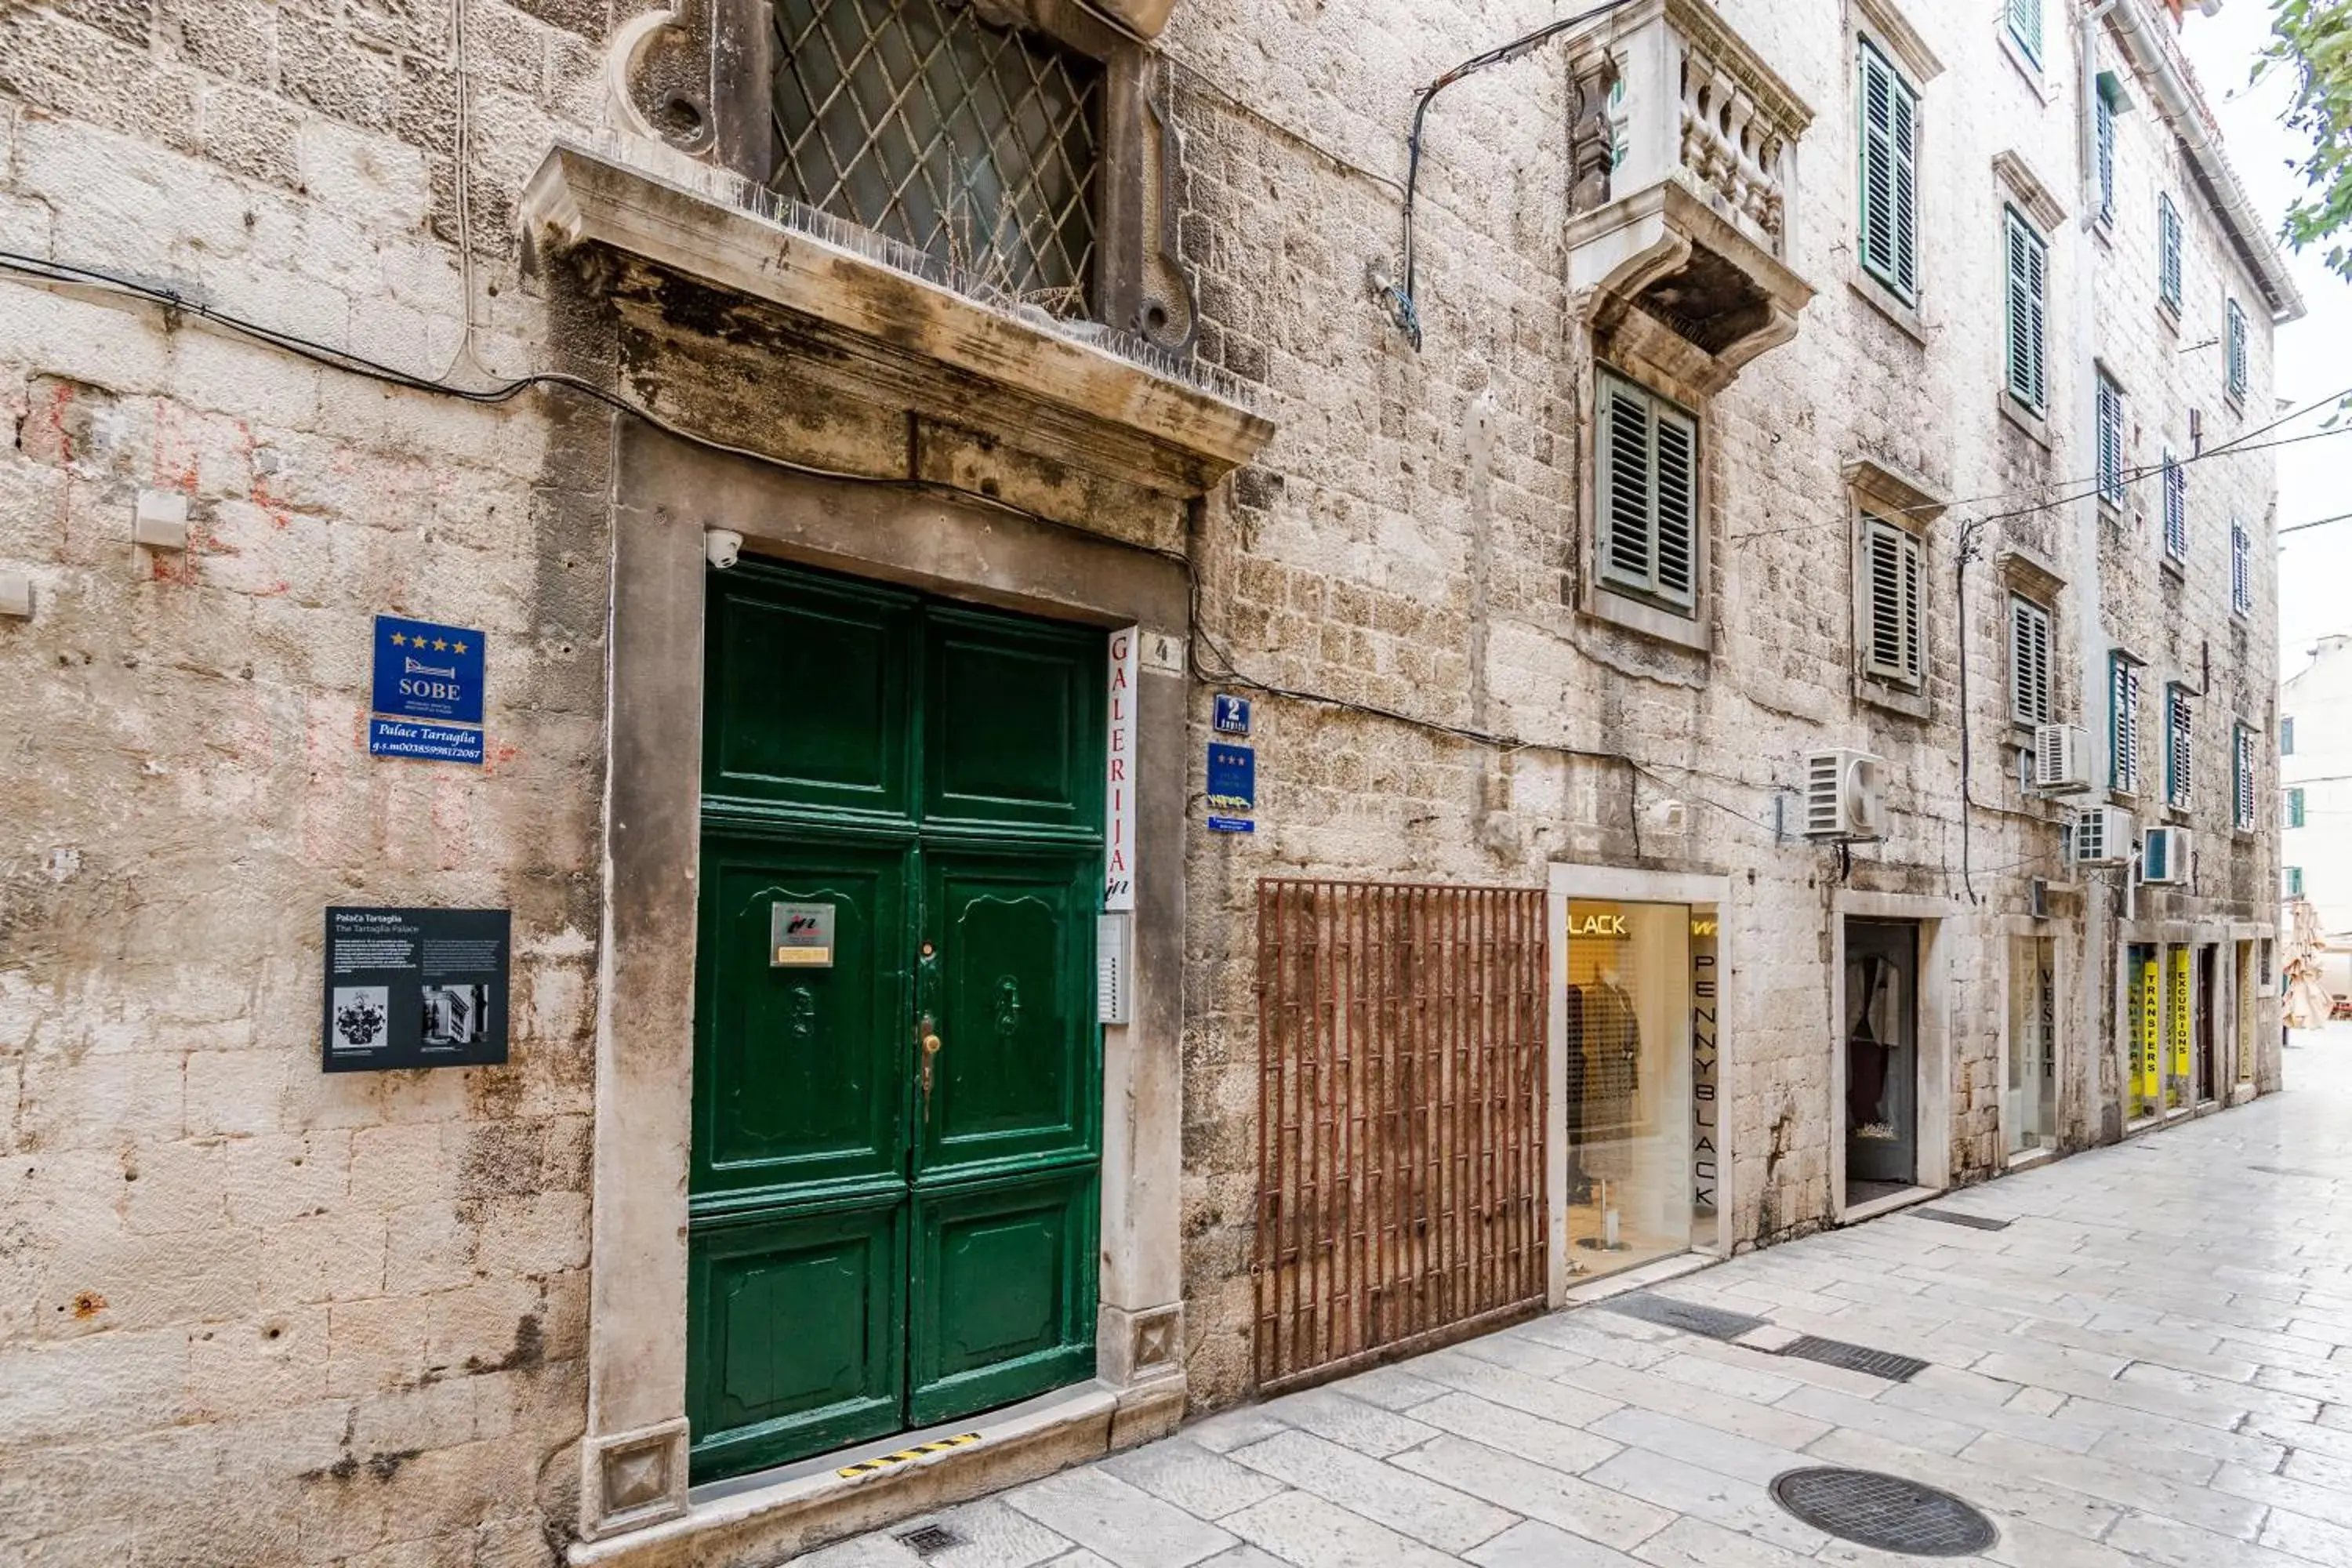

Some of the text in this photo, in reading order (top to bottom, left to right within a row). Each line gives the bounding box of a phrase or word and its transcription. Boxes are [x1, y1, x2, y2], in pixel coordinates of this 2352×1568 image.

[1155, 639, 1167, 661] 4
[399, 678, 461, 701] SOBE
[1229, 698, 1240, 720] 2
[379, 724, 476, 746] Palace Tartaglia
[1109, 636, 1127, 872] GALERIJA
[354, 925, 390, 934] Tartaglia
[365, 914, 402, 924] Tartaglia
[1566, 915, 1626, 935] LACK
[2147, 975, 2157, 1073] TRANSFERS
[2177, 972, 2187, 1054] EXCURSIONS
[1694, 956, 1716, 1205] PENNYBLACK
